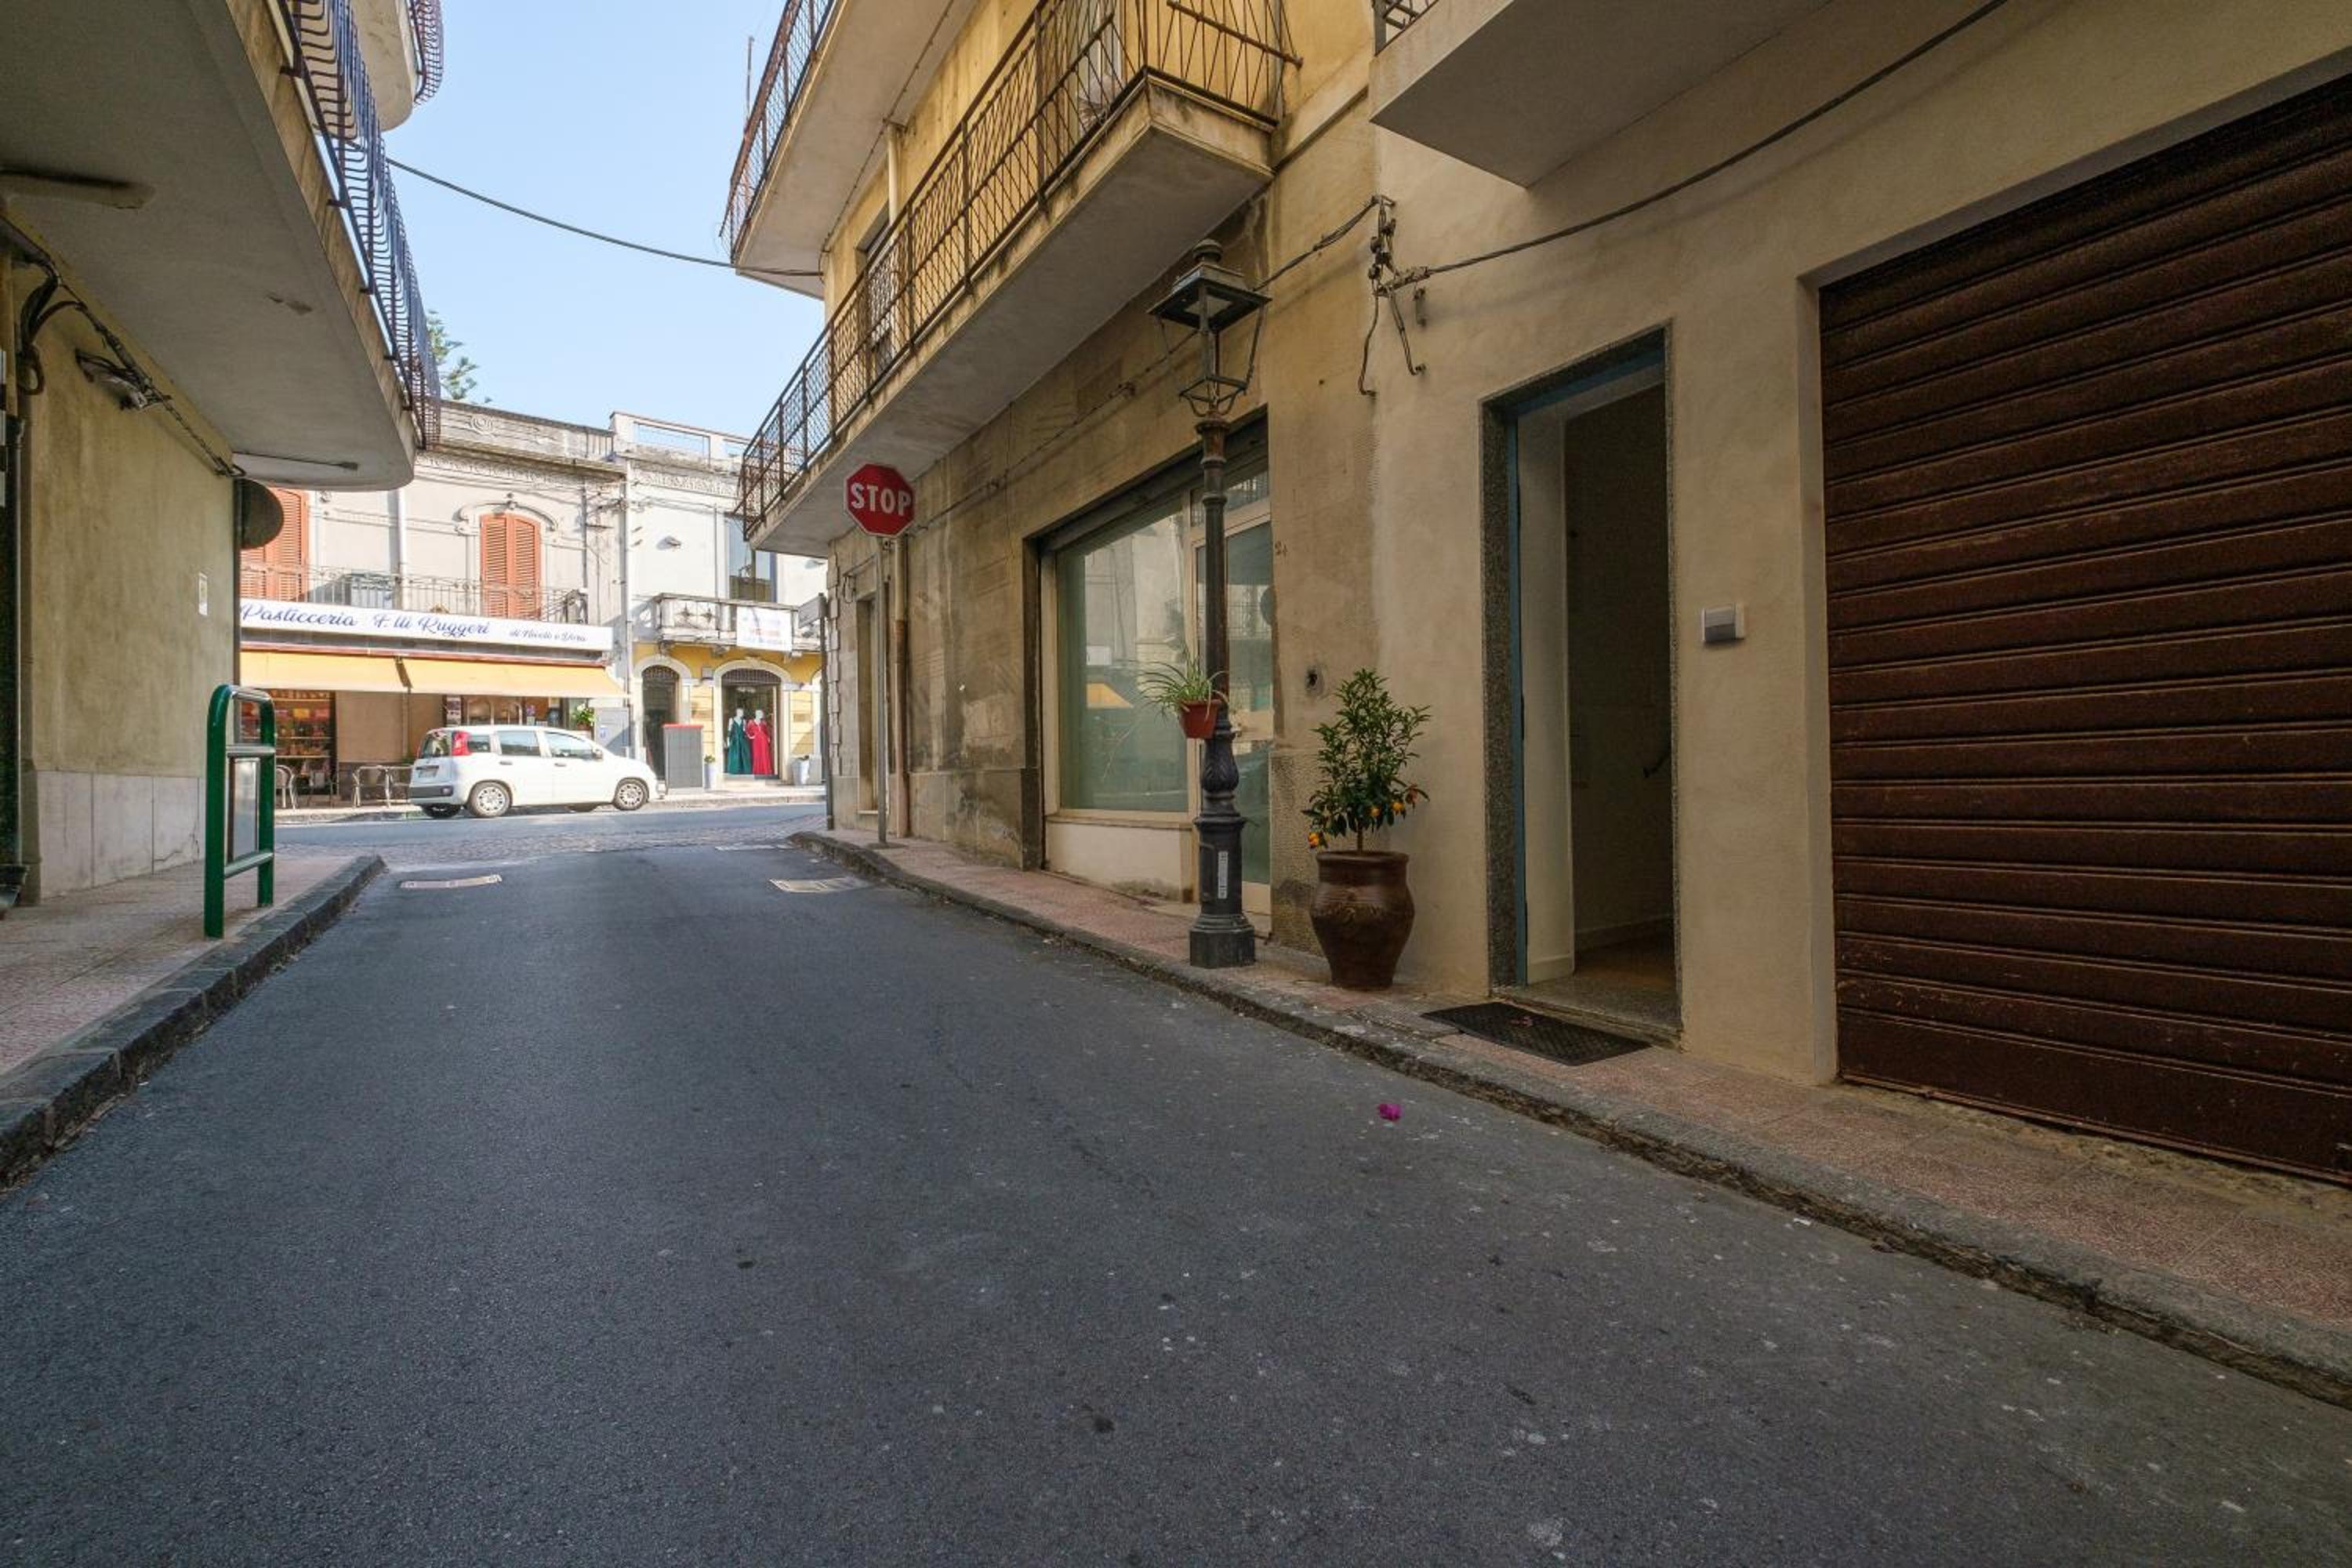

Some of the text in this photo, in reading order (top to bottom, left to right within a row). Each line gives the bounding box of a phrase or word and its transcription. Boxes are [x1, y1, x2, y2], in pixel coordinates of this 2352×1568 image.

[851, 482, 911, 516] STOP
[241, 603, 358, 626] Pasticceria
[418, 615, 490, 637] Ruggeri
